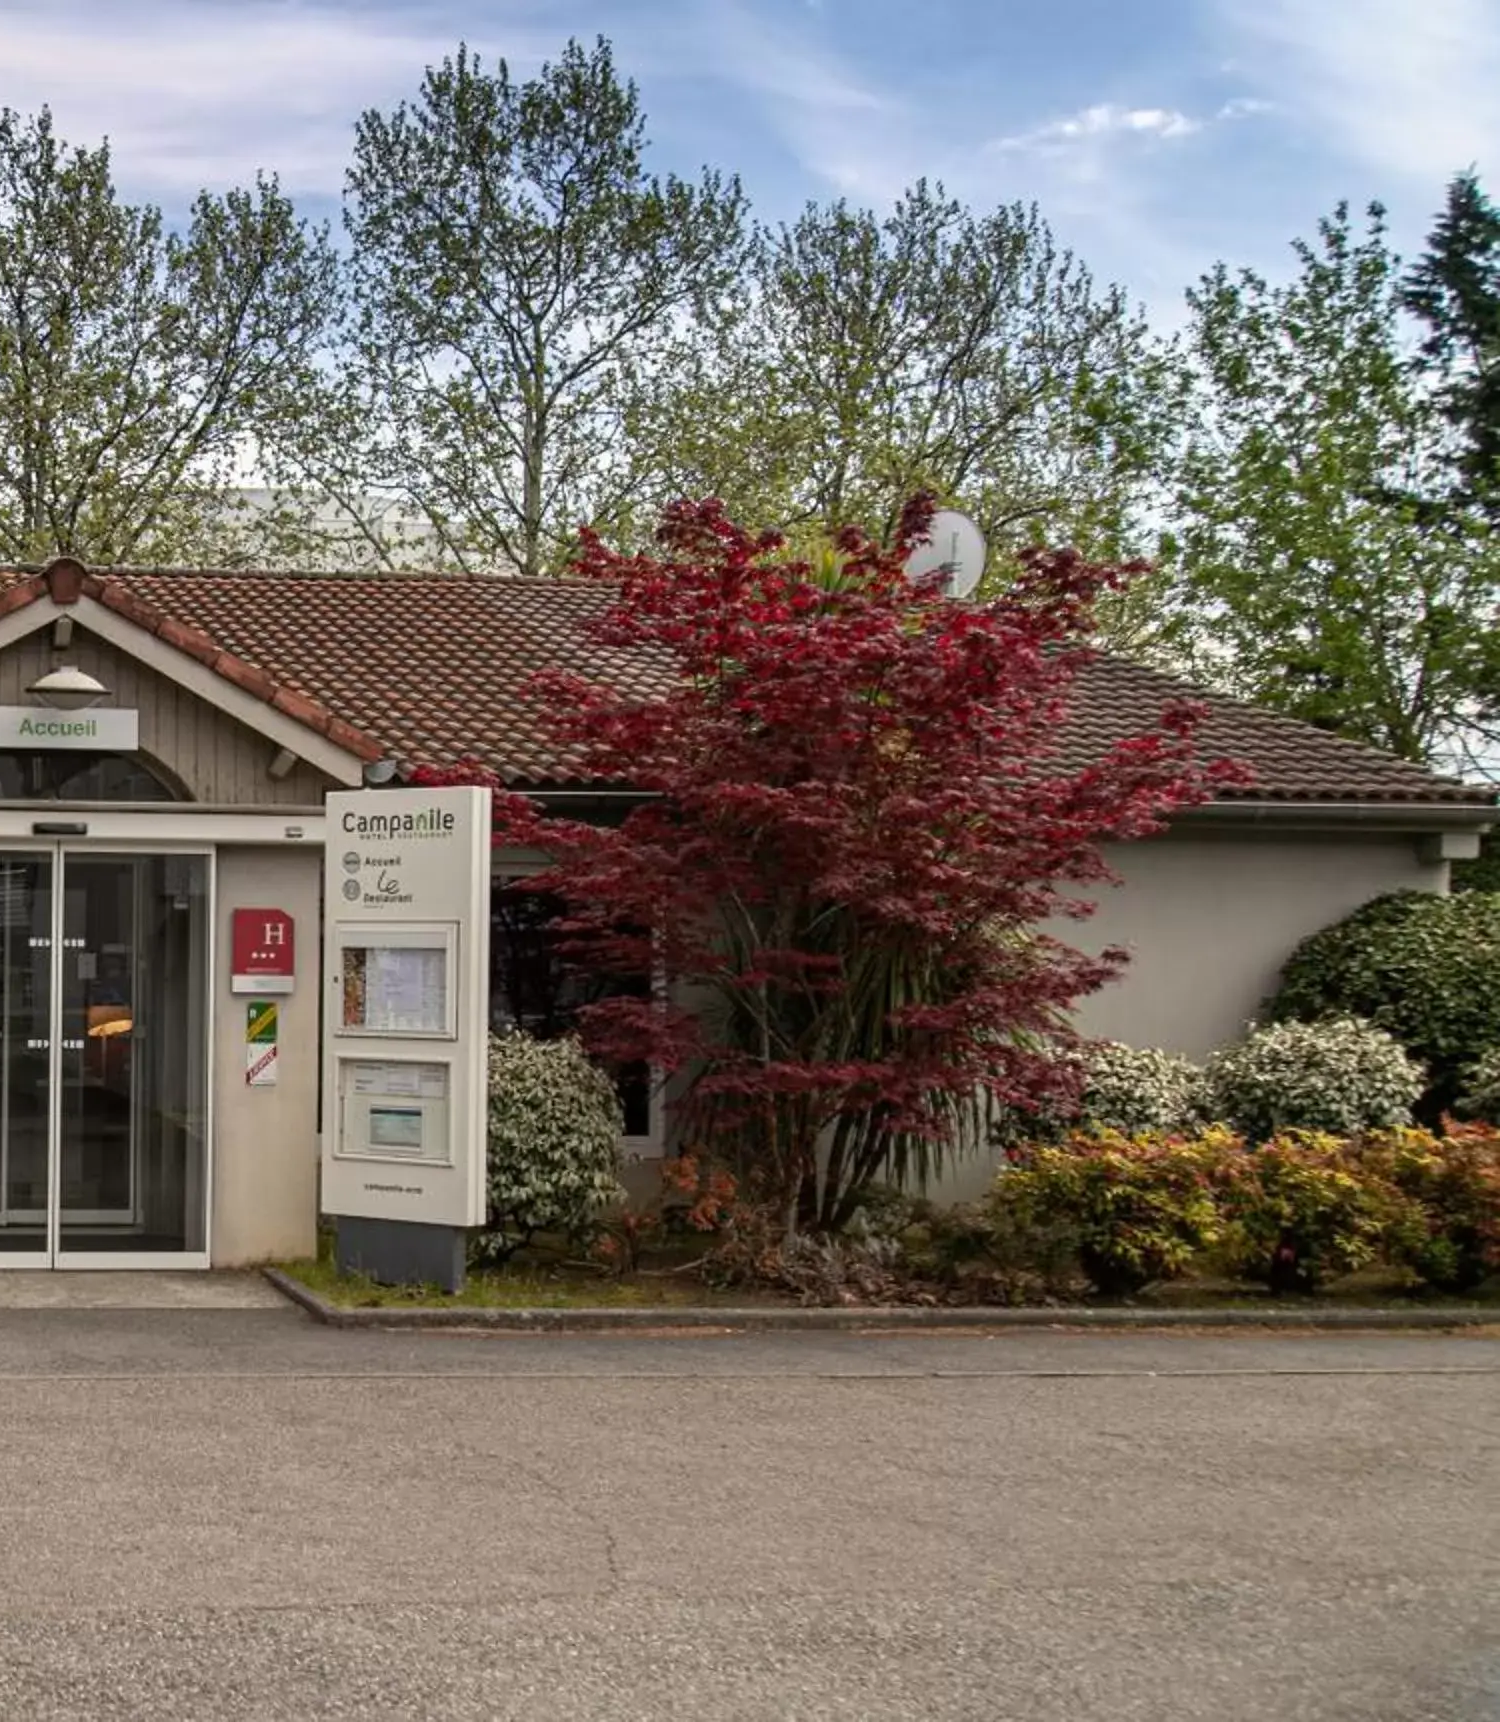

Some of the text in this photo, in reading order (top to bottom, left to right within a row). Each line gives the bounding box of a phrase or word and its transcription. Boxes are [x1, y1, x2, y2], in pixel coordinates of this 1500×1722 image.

[19, 719, 97, 736] Accueil
[342, 808, 455, 839] Campanile
[364, 856, 401, 866] Accueil
[264, 923, 285, 945] H
